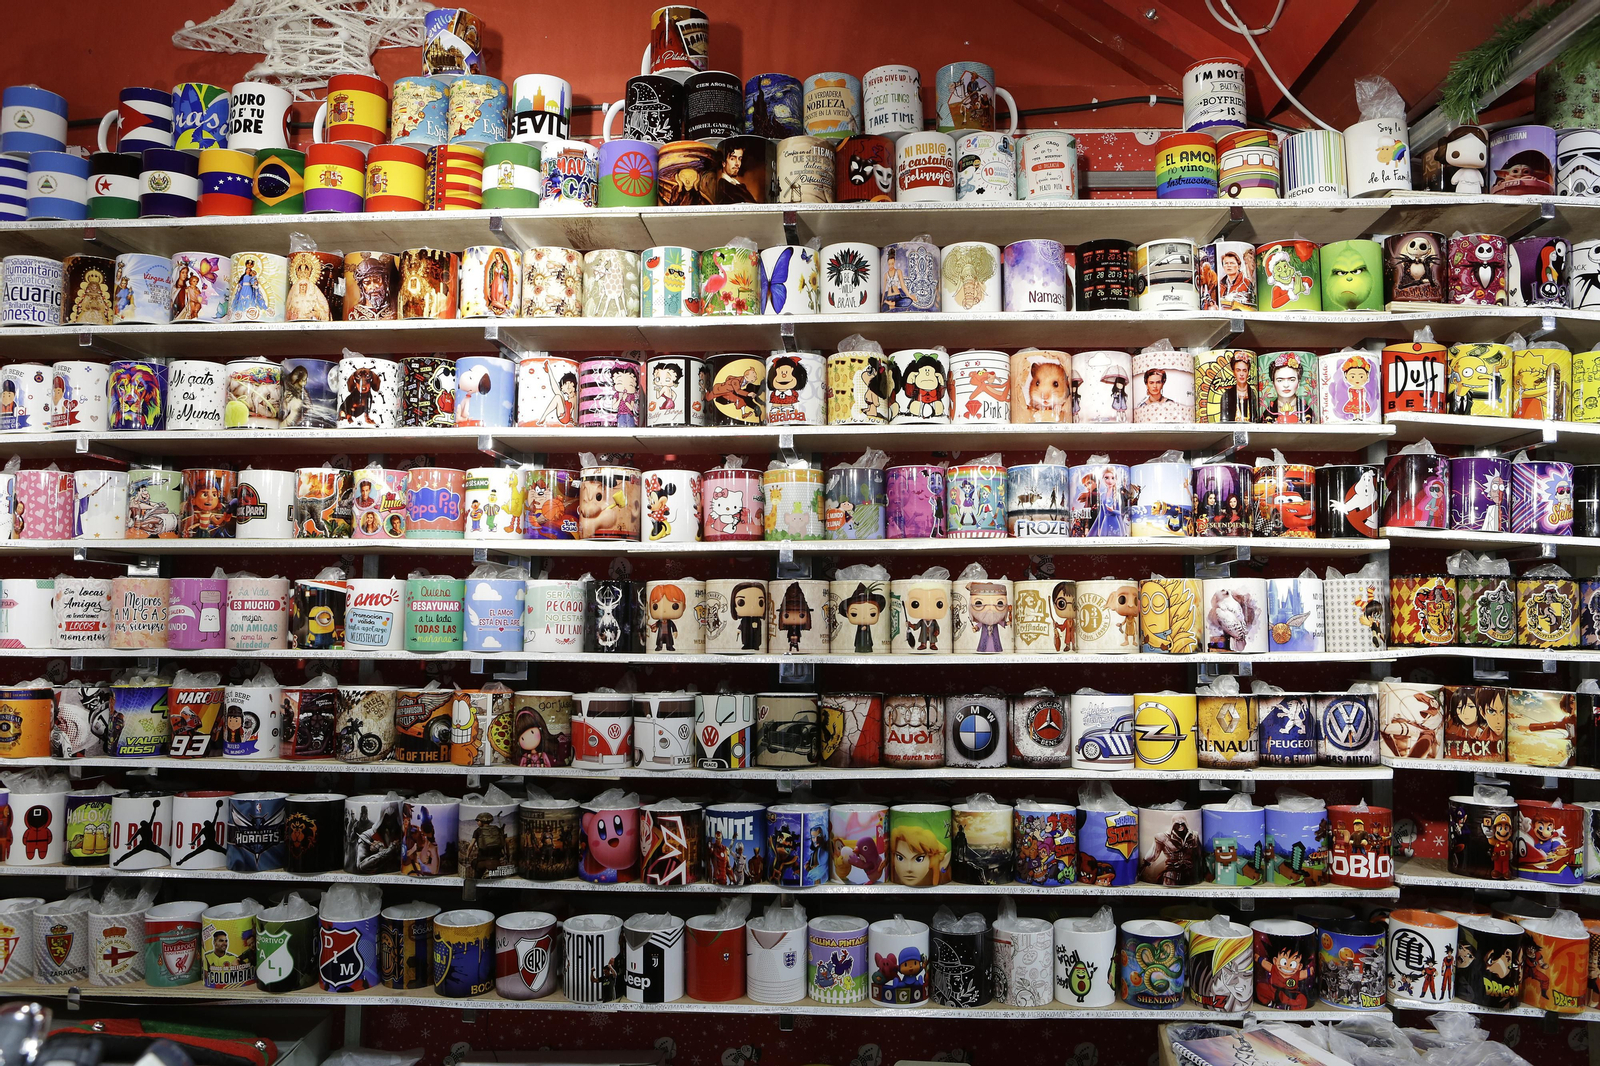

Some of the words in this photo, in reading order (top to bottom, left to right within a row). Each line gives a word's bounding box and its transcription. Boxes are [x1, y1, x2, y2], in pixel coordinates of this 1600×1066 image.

[868, 77, 883, 87] NEVER
[884, 74, 898, 82] GIVE
[1194, 71, 1213, 83] I'M
[1217, 70, 1238, 80] NOT
[814, 91, 842, 100] VERDADERA
[891, 93, 910, 104] THINGS
[806, 99, 846, 110] NOBLEZA
[250, 108, 264, 118] TU
[1227, 107, 1236, 115] IS
[869, 114, 896, 127] TAKE
[897, 113, 915, 126] TIME
[905, 147, 914, 158] NI
[915, 143, 947, 157] RUBI@
[908, 156, 954, 169] castañ@
[1166, 154, 1176, 167] EL
[1179, 150, 1216, 165] AMOR
[984, 167, 995, 176] 10
[1179, 163, 1204, 173] vino
[1379, 171, 1390, 182] la
[1288, 186, 1313, 199] HECHO
[6, 263, 59, 279] Humanitario
[1096, 271, 1105, 279] 28
[1107, 271, 1122, 279] 2013
[837, 296, 857, 307] BRAVE
[1394, 355, 1438, 398] Duff
[177, 403, 221, 422] Mundo
[439, 491, 458, 517] Pig
[245, 505, 264, 517] PARK
[79, 587, 105, 597] locas
[546, 591, 571, 599] SERÍA
[64, 597, 110, 613] Amigas
[124, 591, 162, 612] Mejores
[233, 601, 242, 610] ES
[244, 601, 275, 610] MUCHO
[412, 601, 459, 611] BESAYUNAR
[546, 600, 583, 612] PECADO
[114, 607, 167, 621] AMIGAS
[353, 612, 383, 621] Promoción
[426, 614, 434, 622] tu
[545, 614, 560, 622] NO
[71, 622, 96, 631] LOCOS
[130, 621, 164, 635] siempre
[231, 624, 243, 632] CON
[247, 624, 278, 633] AMIGAS
[414, 624, 440, 633] TODAS
[442, 624, 457, 633] LAS
[545, 624, 552, 634] A
[556, 624, 565, 634] TU
[60, 632, 106, 642] momentos
[236, 640, 271, 649] alrededor
[956, 706, 996, 722] BMW
[1327, 701, 1368, 747] VW
[888, 730, 932, 744] Audi
[170, 735, 211, 756] 93
[1269, 740, 1314, 748] PEUGEOT
[119, 745, 156, 755] ROSSI
[406, 751, 418, 761] OF
[419, 750, 438, 760] THE
[236, 832, 280, 844] HORNETS
[164, 943, 195, 952] LIVERPOOL
[50, 966, 87, 978] ZARAGOZA
[624, 970, 651, 989] Jeep
[1137, 994, 1180, 1005] SHENLONG
[1215, 995, 1226, 1008] Z
